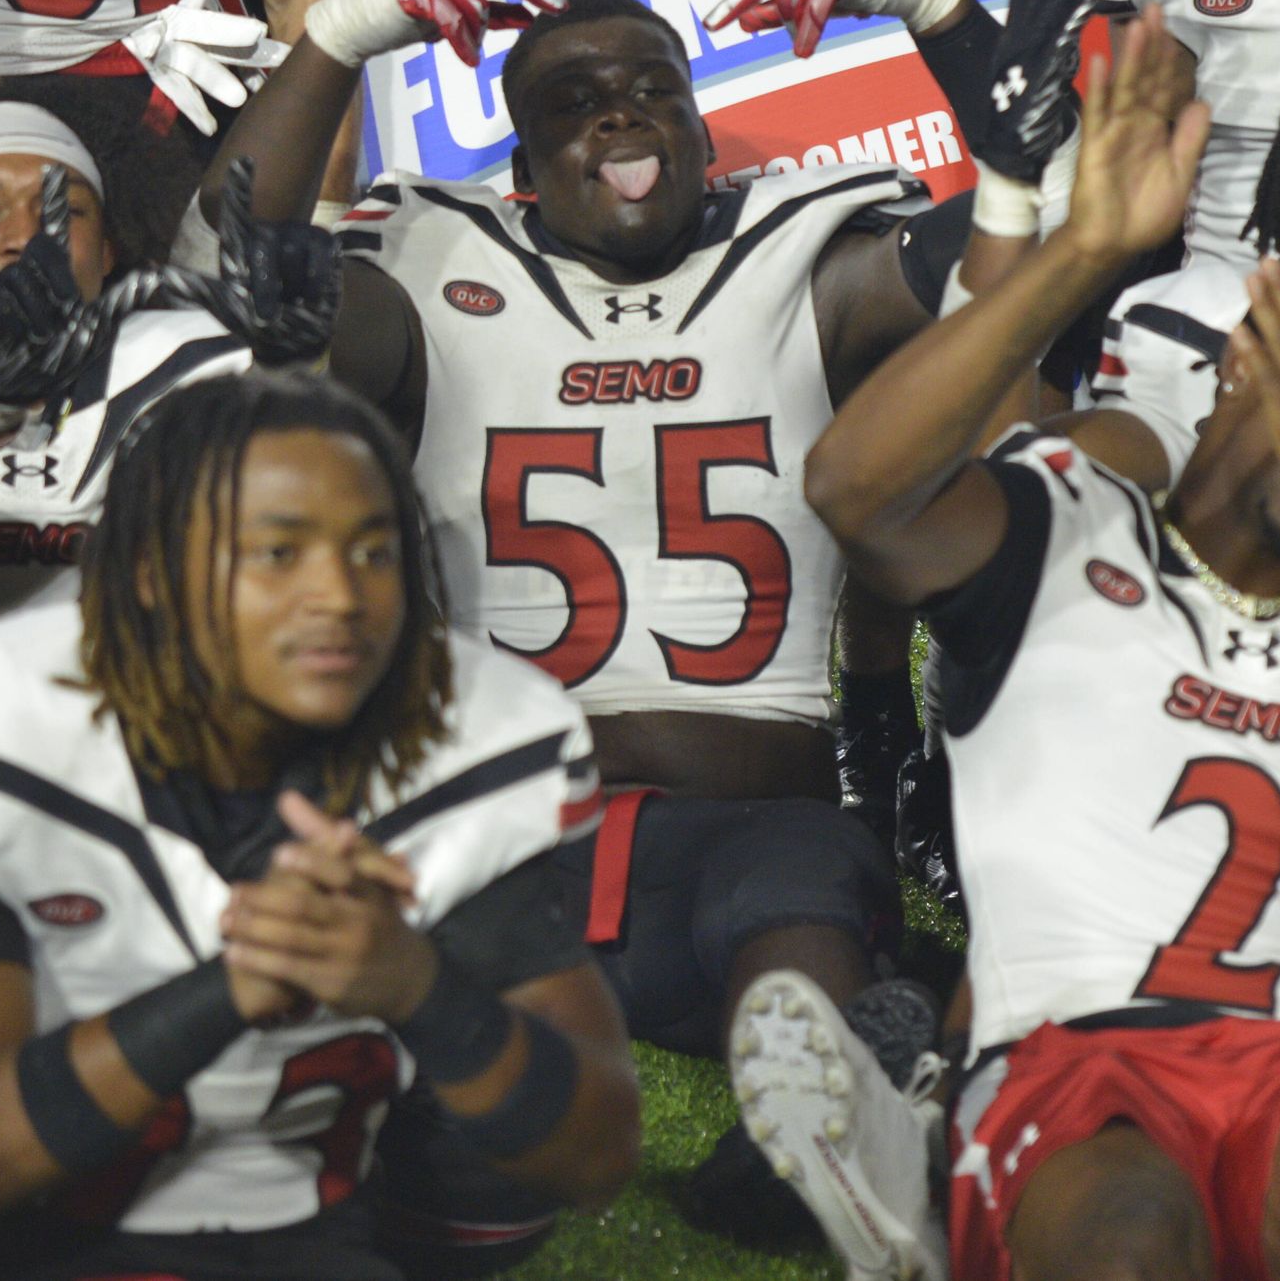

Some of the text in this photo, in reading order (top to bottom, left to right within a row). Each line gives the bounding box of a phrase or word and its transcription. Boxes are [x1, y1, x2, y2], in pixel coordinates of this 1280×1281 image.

[456, 290, 489, 307] OVC
[559, 357, 702, 405] SEMO
[481, 415, 792, 690] 55
